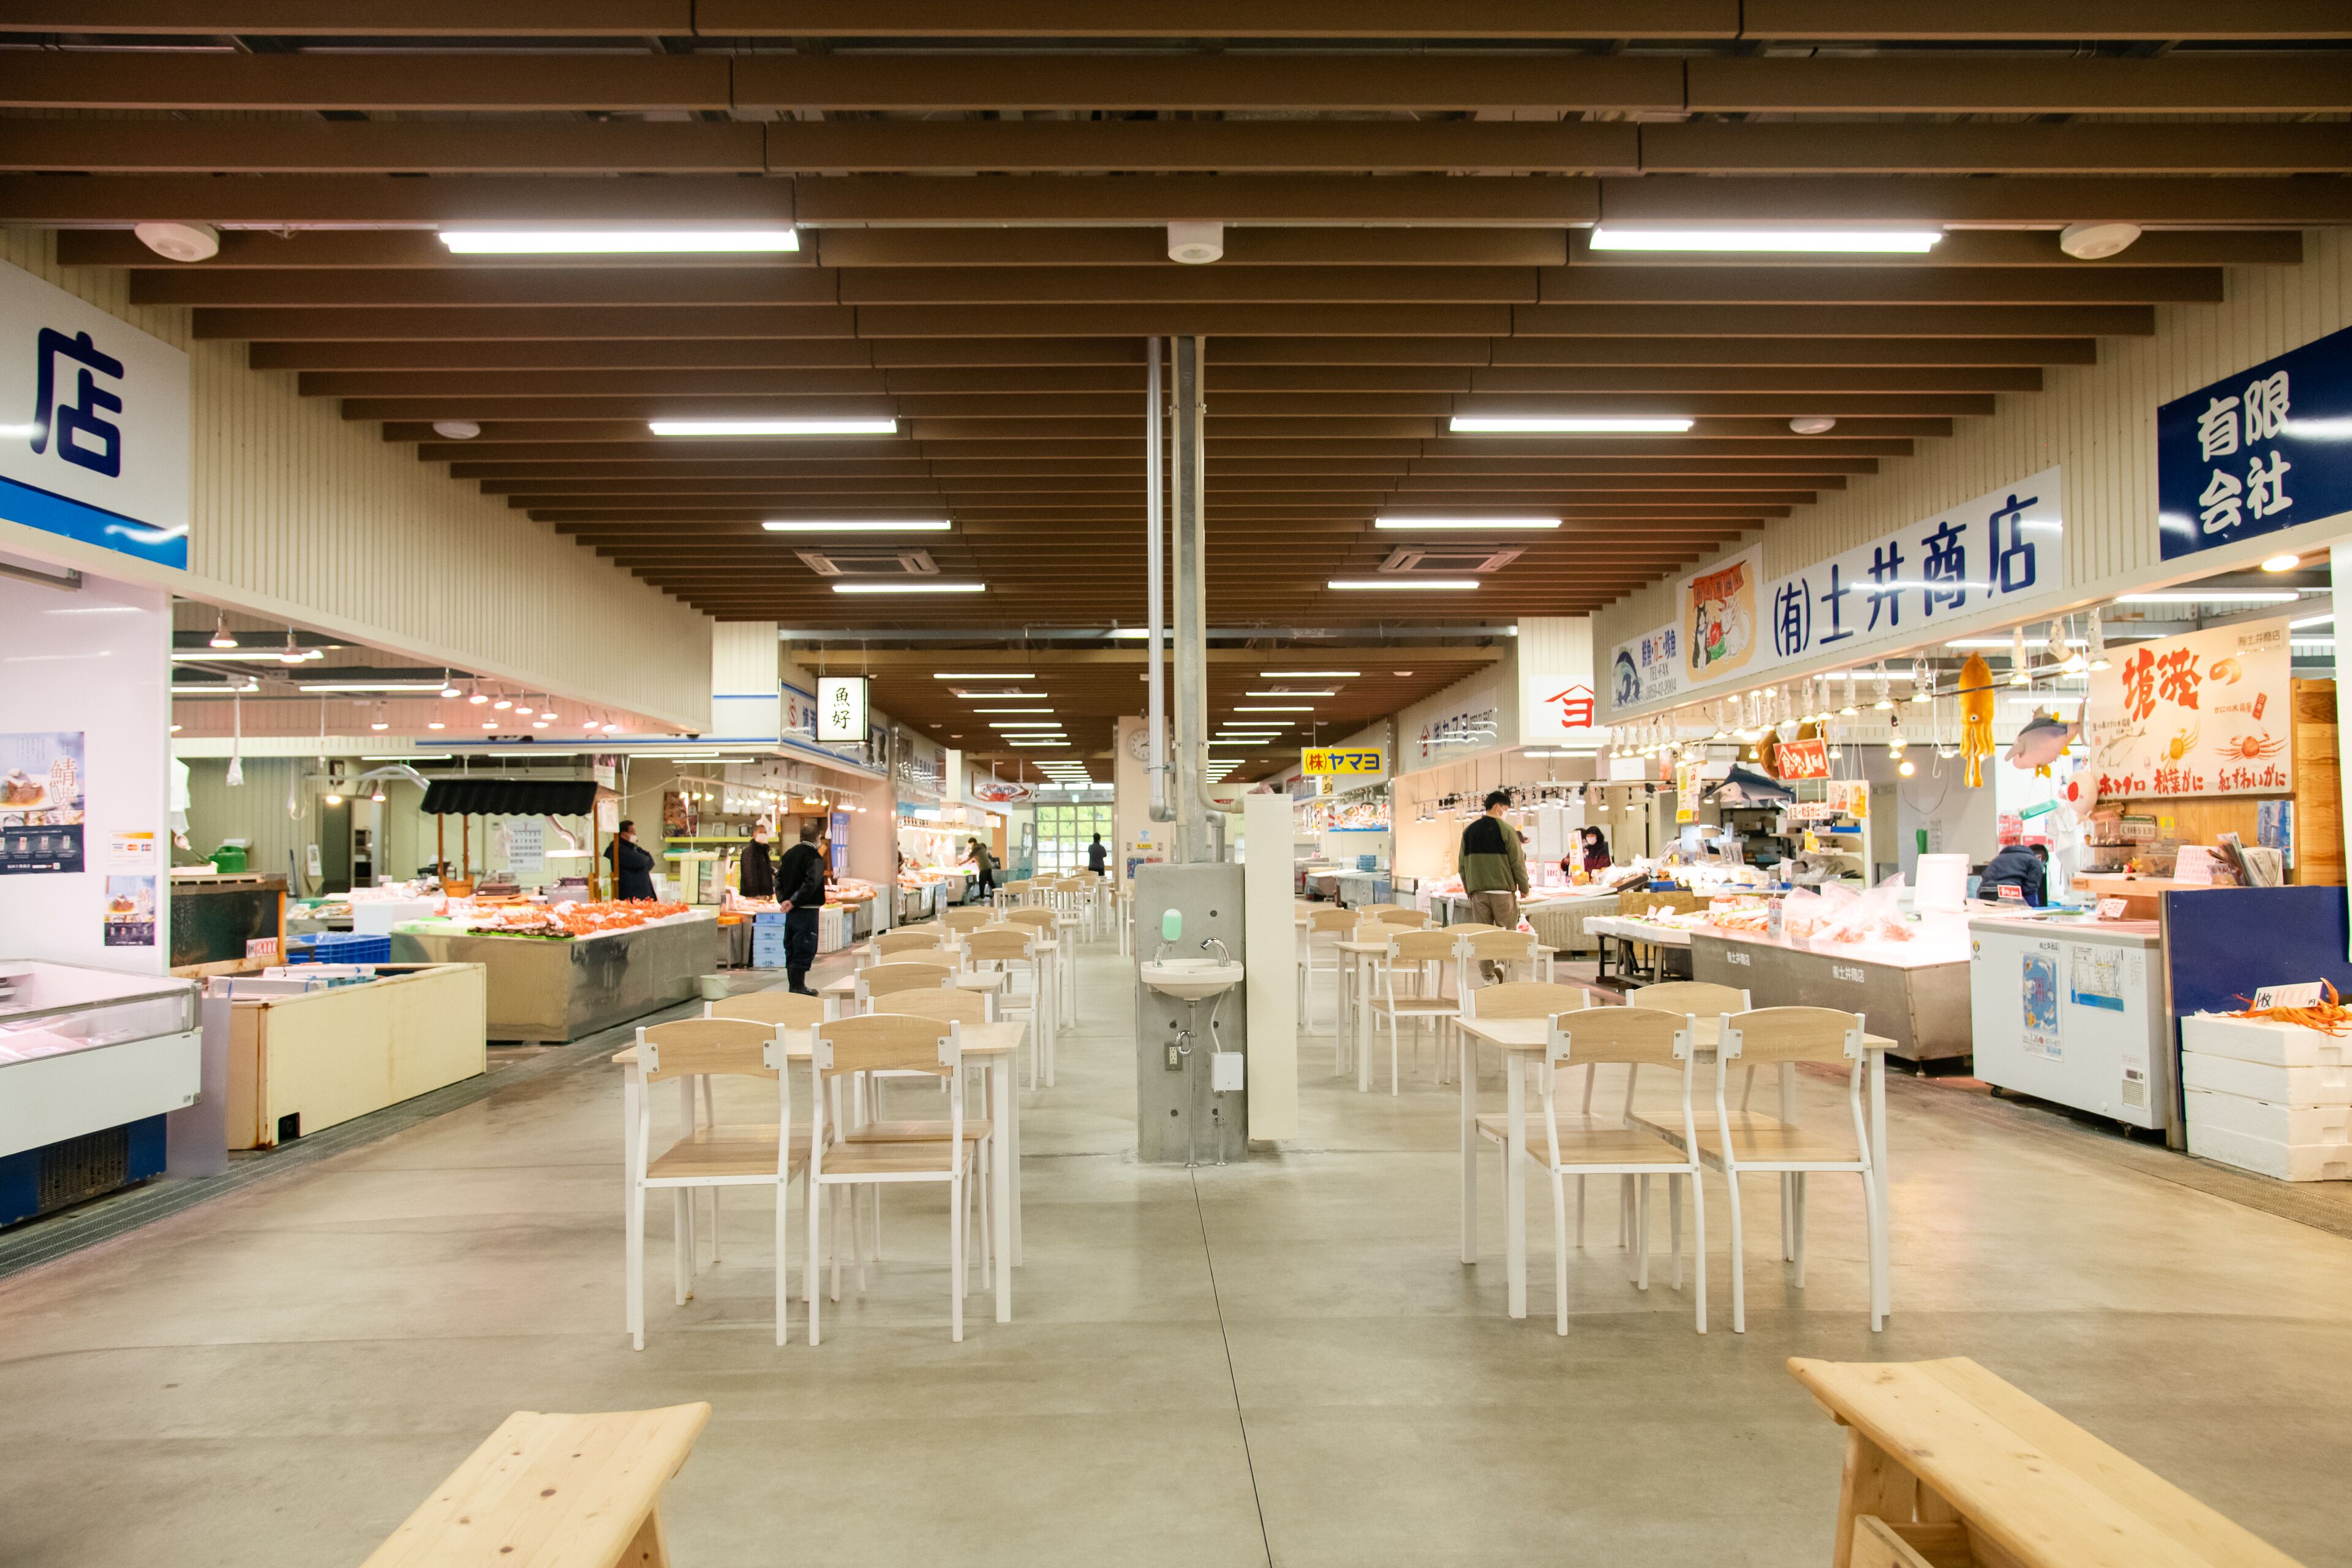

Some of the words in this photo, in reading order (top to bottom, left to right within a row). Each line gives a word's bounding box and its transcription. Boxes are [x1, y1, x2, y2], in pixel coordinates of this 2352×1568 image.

[30, 326, 124, 478] 店
[2197, 370, 2291, 462] 有限
[2199, 450, 2293, 534] 会社
[1774, 494, 2039, 658] (有)土井商店
[832, 687, 851, 729] 魚好
[1306, 753, 1379, 771] (株)ヤマヨ
[2154, 768, 2203, 795] 松葉がに
[2218, 763, 2286, 793] 紅ずわいがに
